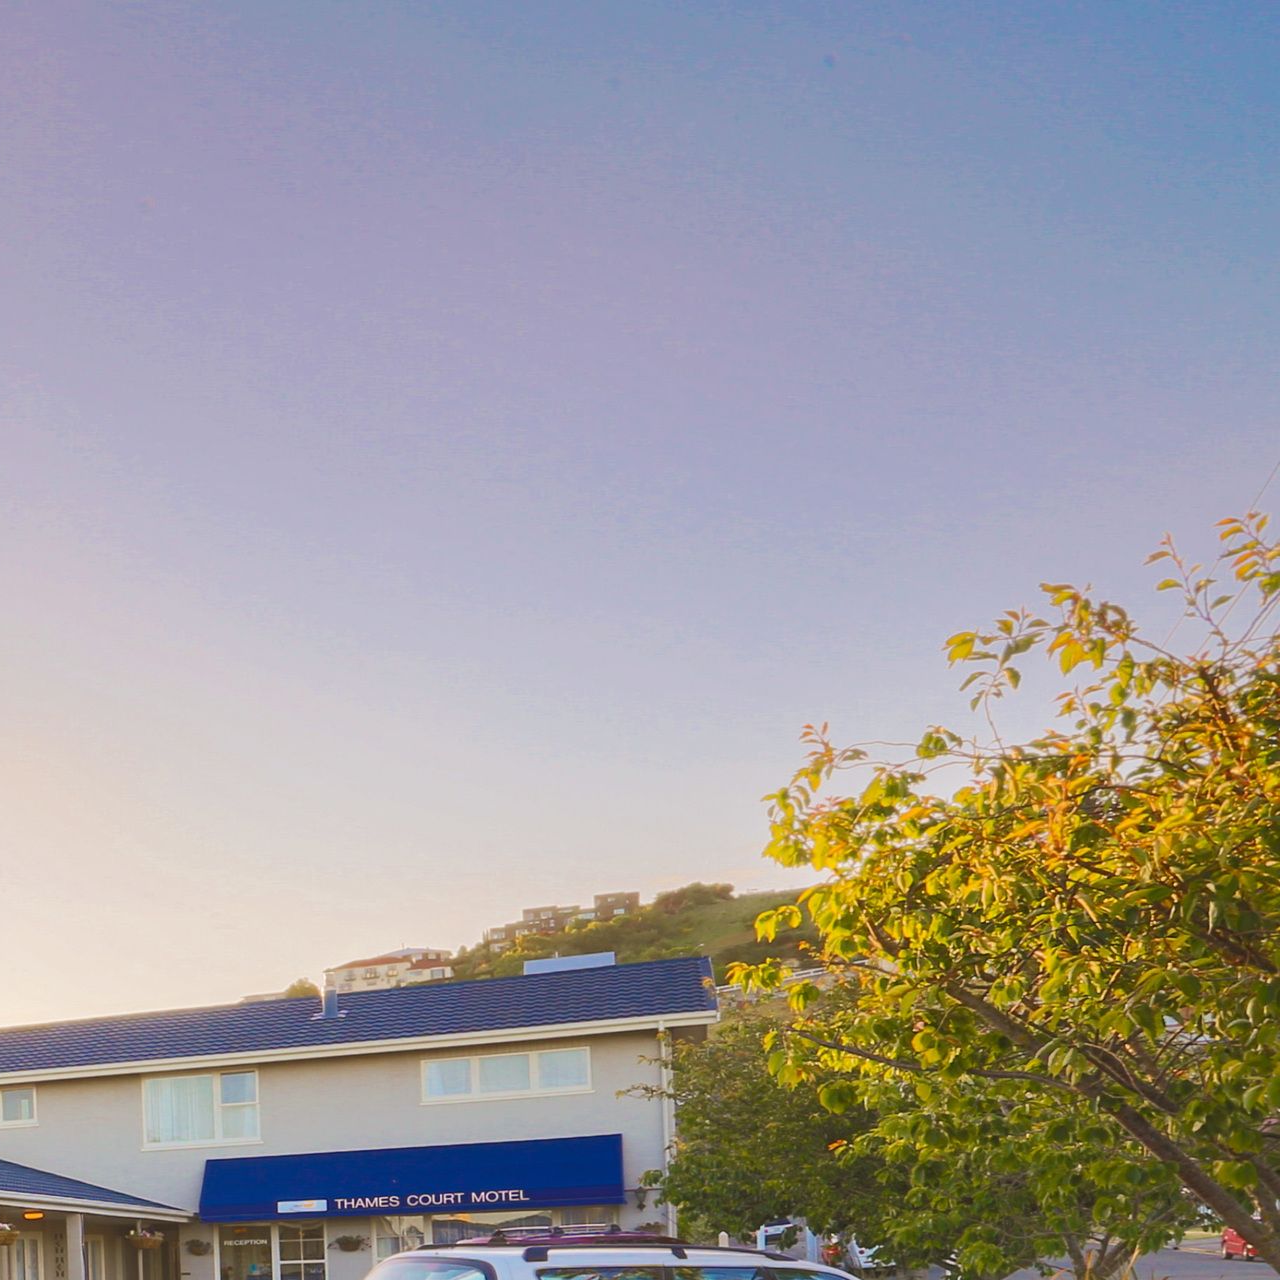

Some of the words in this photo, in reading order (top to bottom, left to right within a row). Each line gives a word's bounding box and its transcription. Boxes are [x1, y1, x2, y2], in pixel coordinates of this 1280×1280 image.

[334, 1195, 400, 1210] THAMES
[406, 1192, 464, 1207] COURT
[471, 1189, 530, 1204] MOTEL
[223, 1239, 268, 1247] RECEPTION
